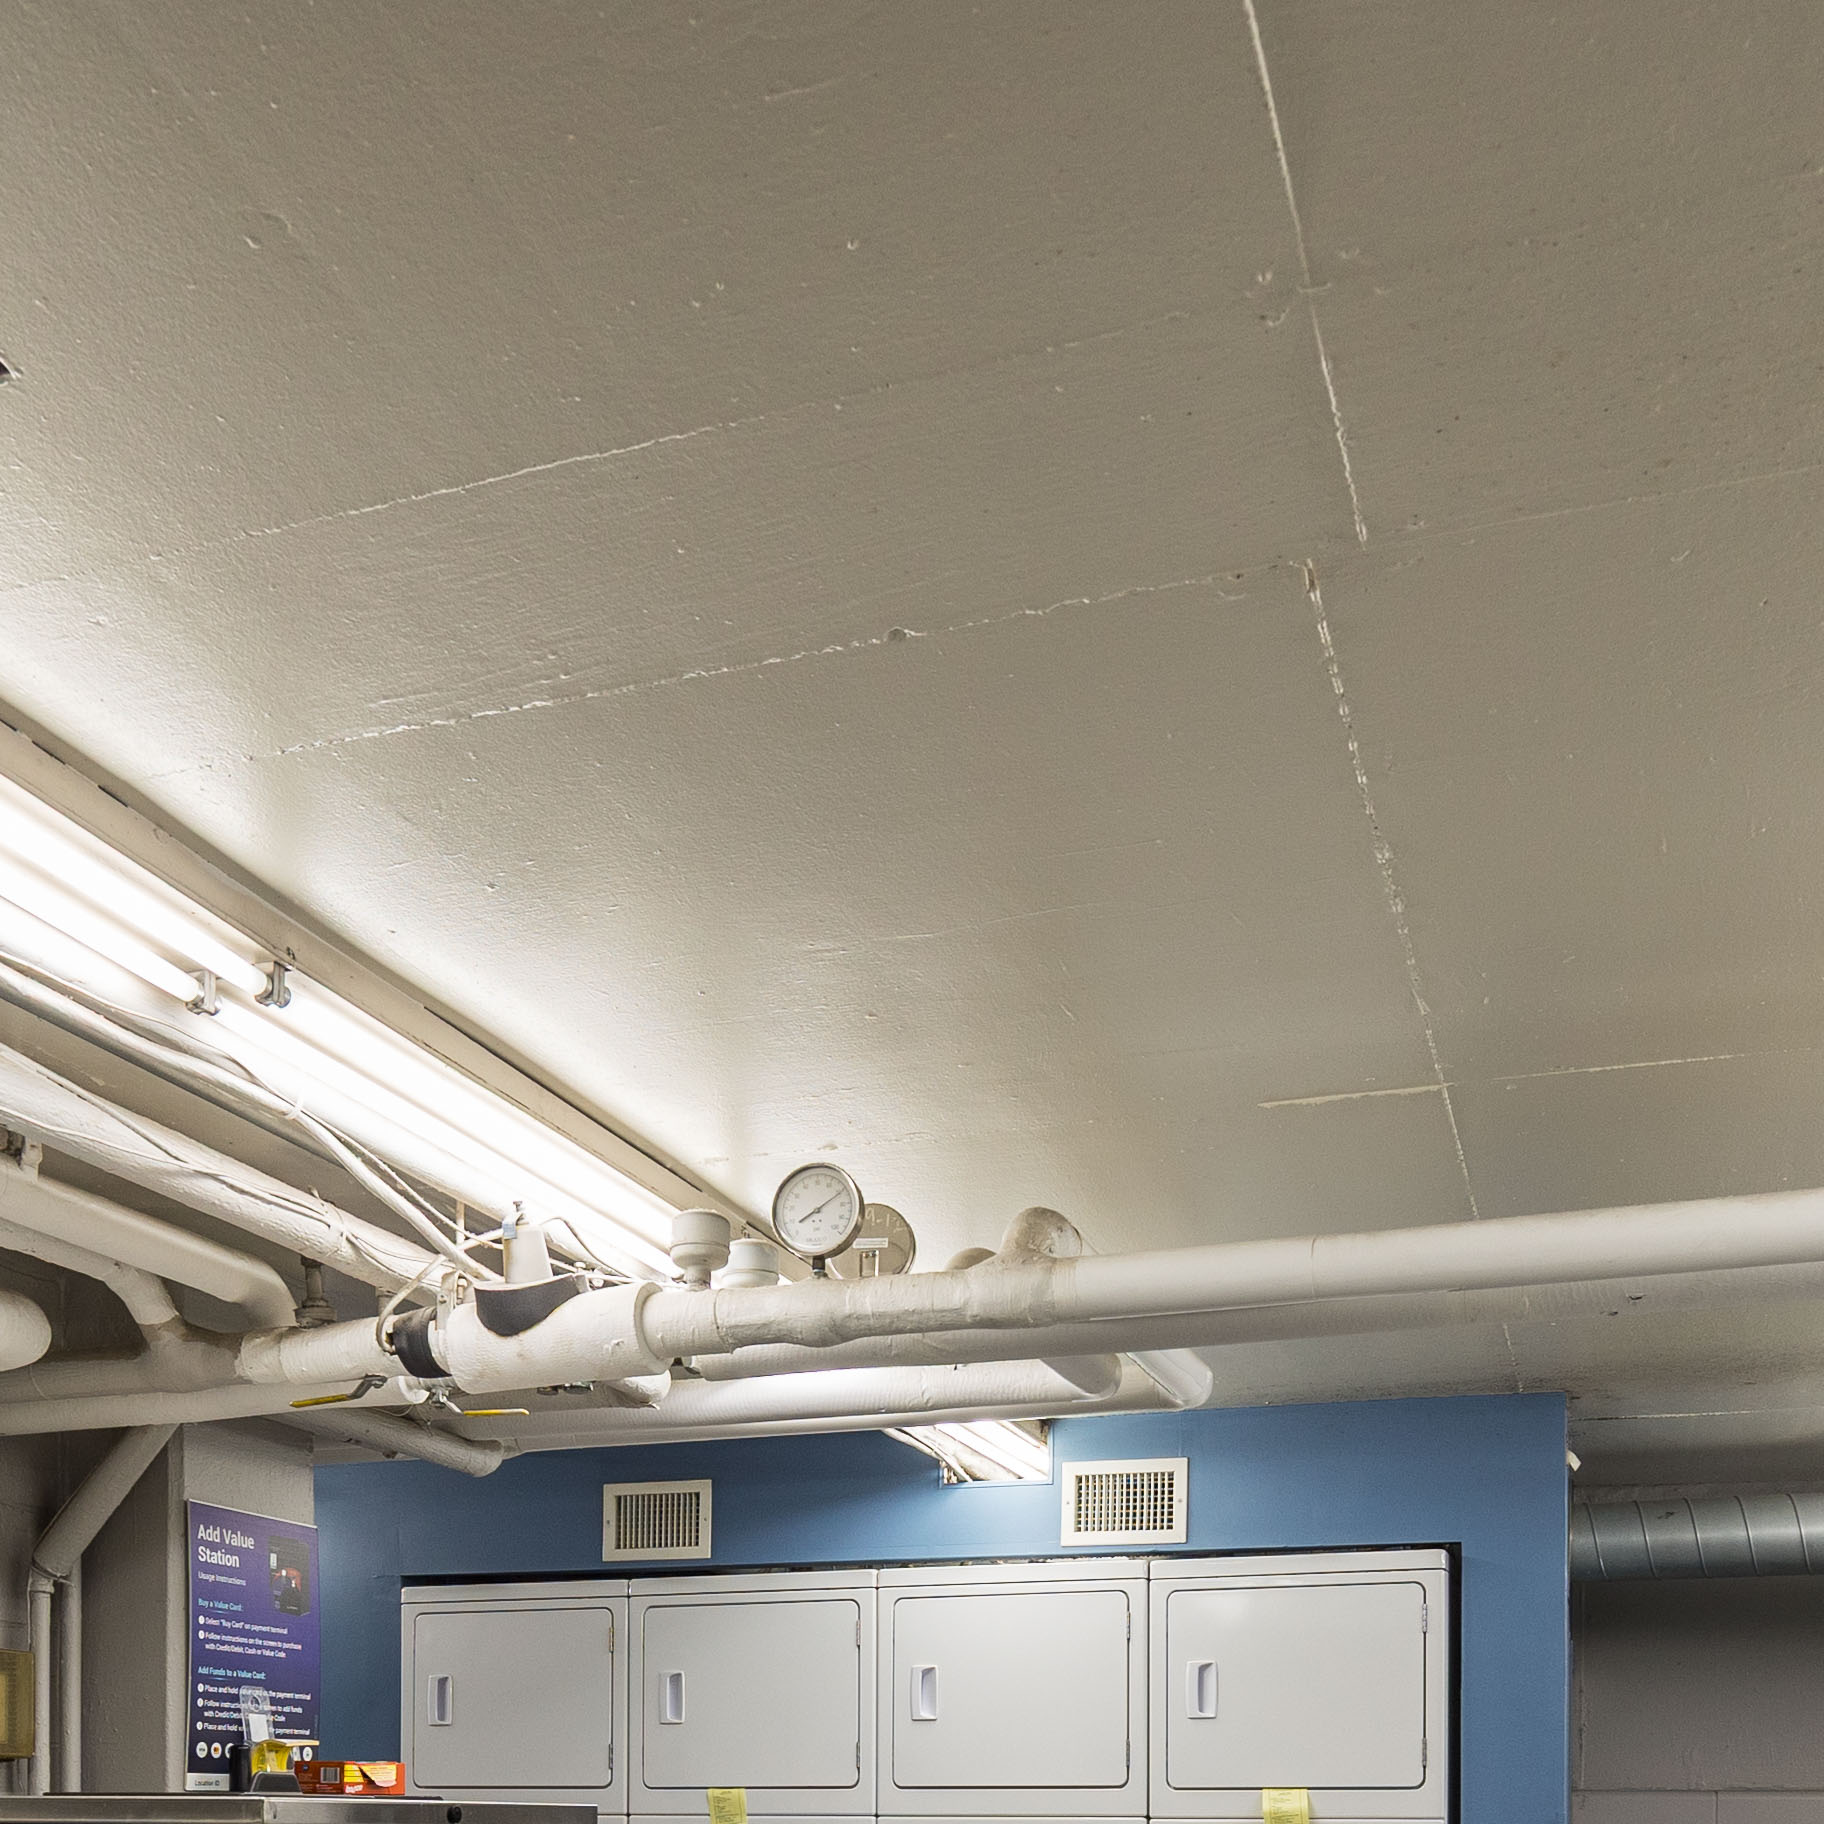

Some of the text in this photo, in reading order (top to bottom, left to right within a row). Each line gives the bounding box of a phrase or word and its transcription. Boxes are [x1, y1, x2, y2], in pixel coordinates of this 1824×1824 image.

[197, 1524, 255, 1549] Add Value
[198, 1546, 240, 1568] Station
[198, 1571, 247, 1587] Usage Instructions
